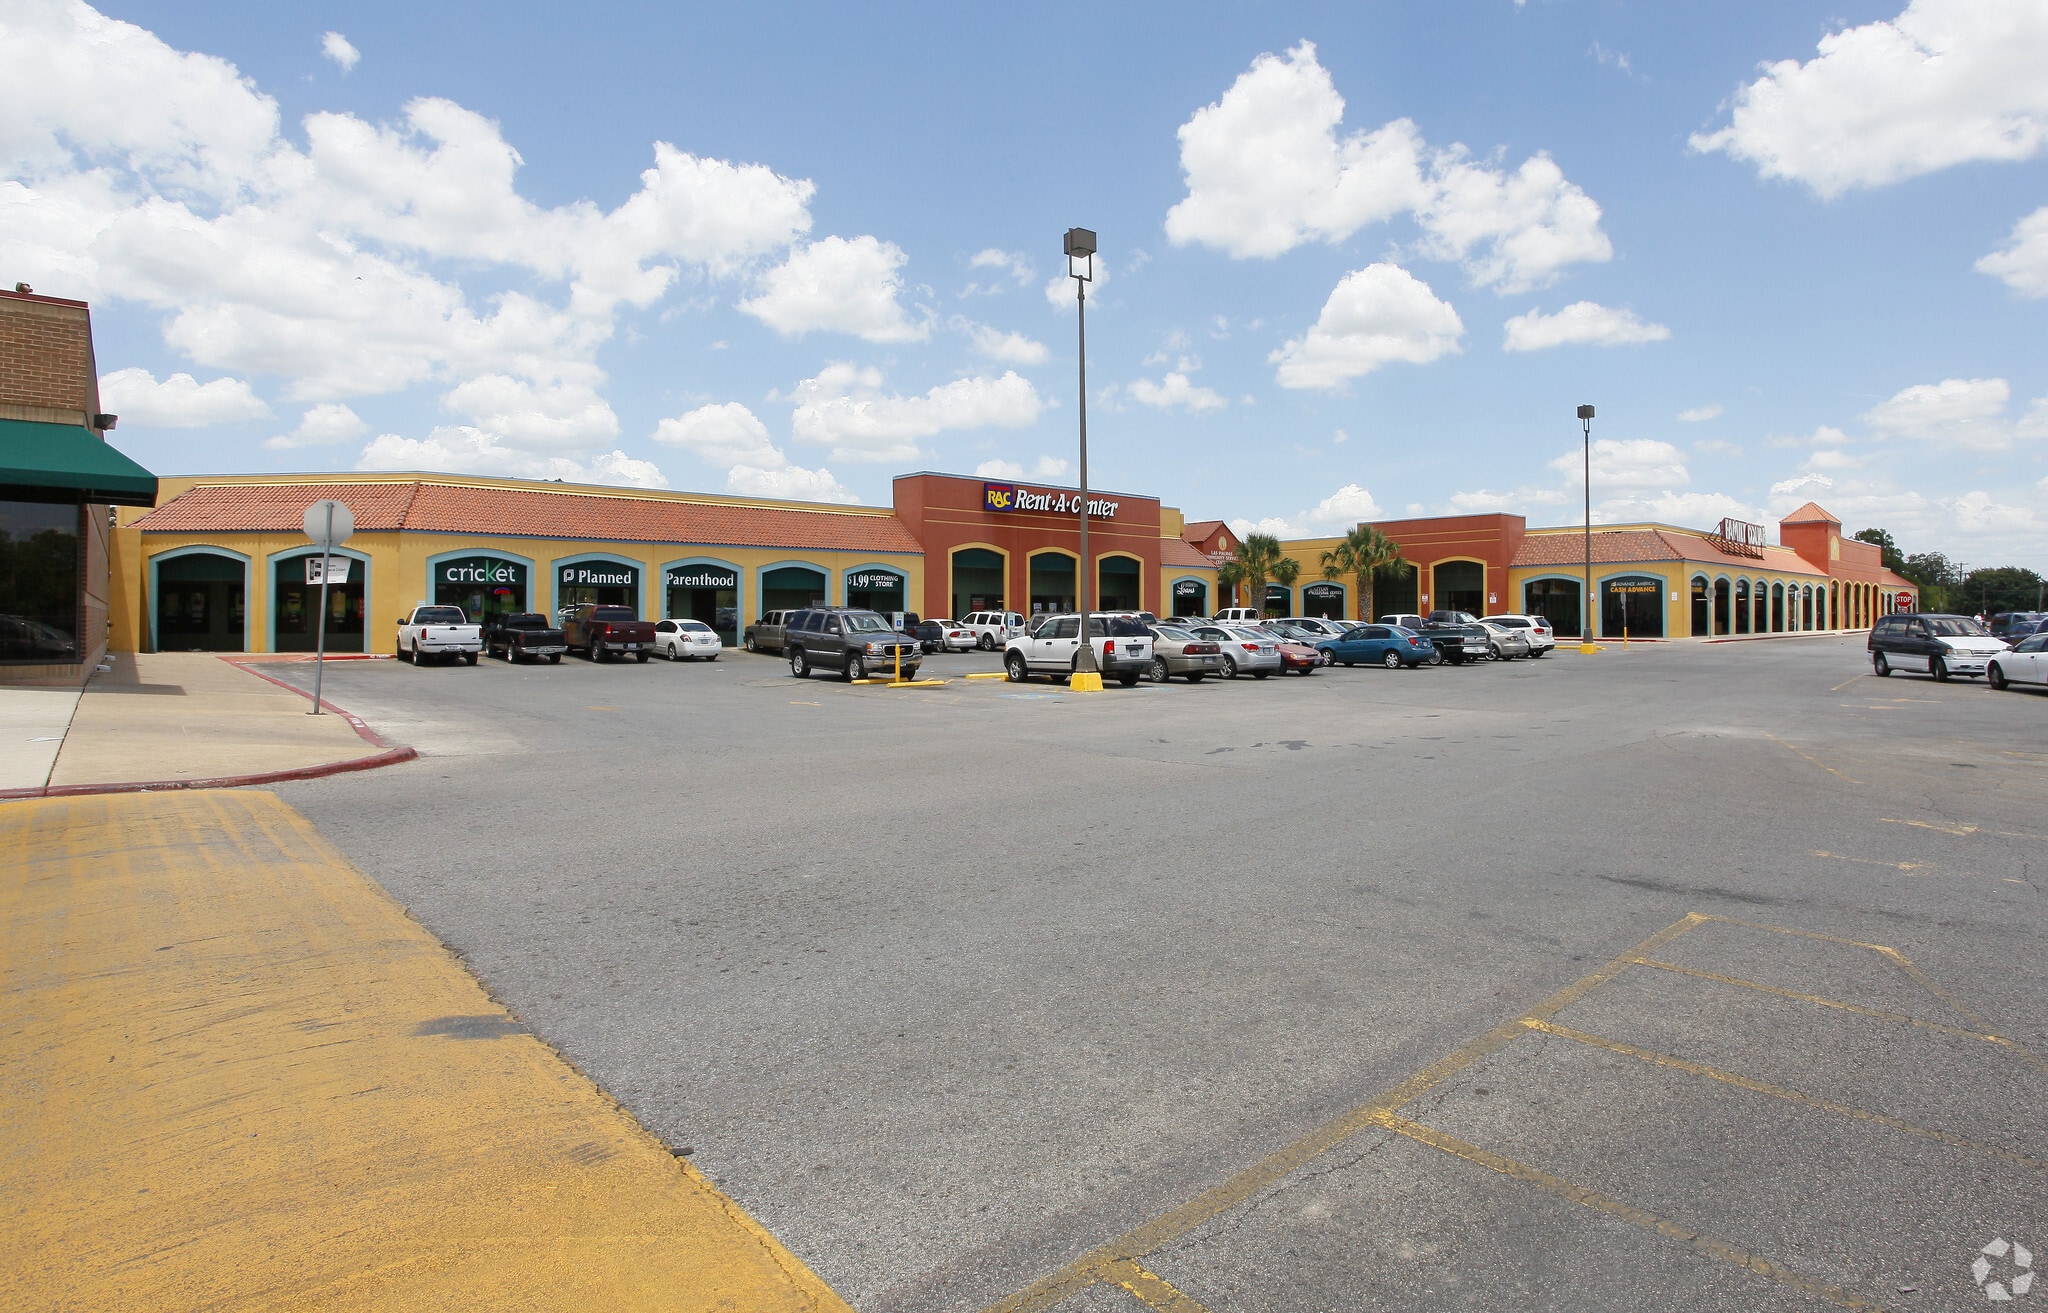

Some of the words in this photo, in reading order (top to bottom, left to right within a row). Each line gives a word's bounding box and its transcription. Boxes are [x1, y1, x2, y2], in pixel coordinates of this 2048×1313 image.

[578, 569, 632, 584] Planned
[666, 572, 734, 586] Parenthood
[847, 574, 869, 588] $1.99
